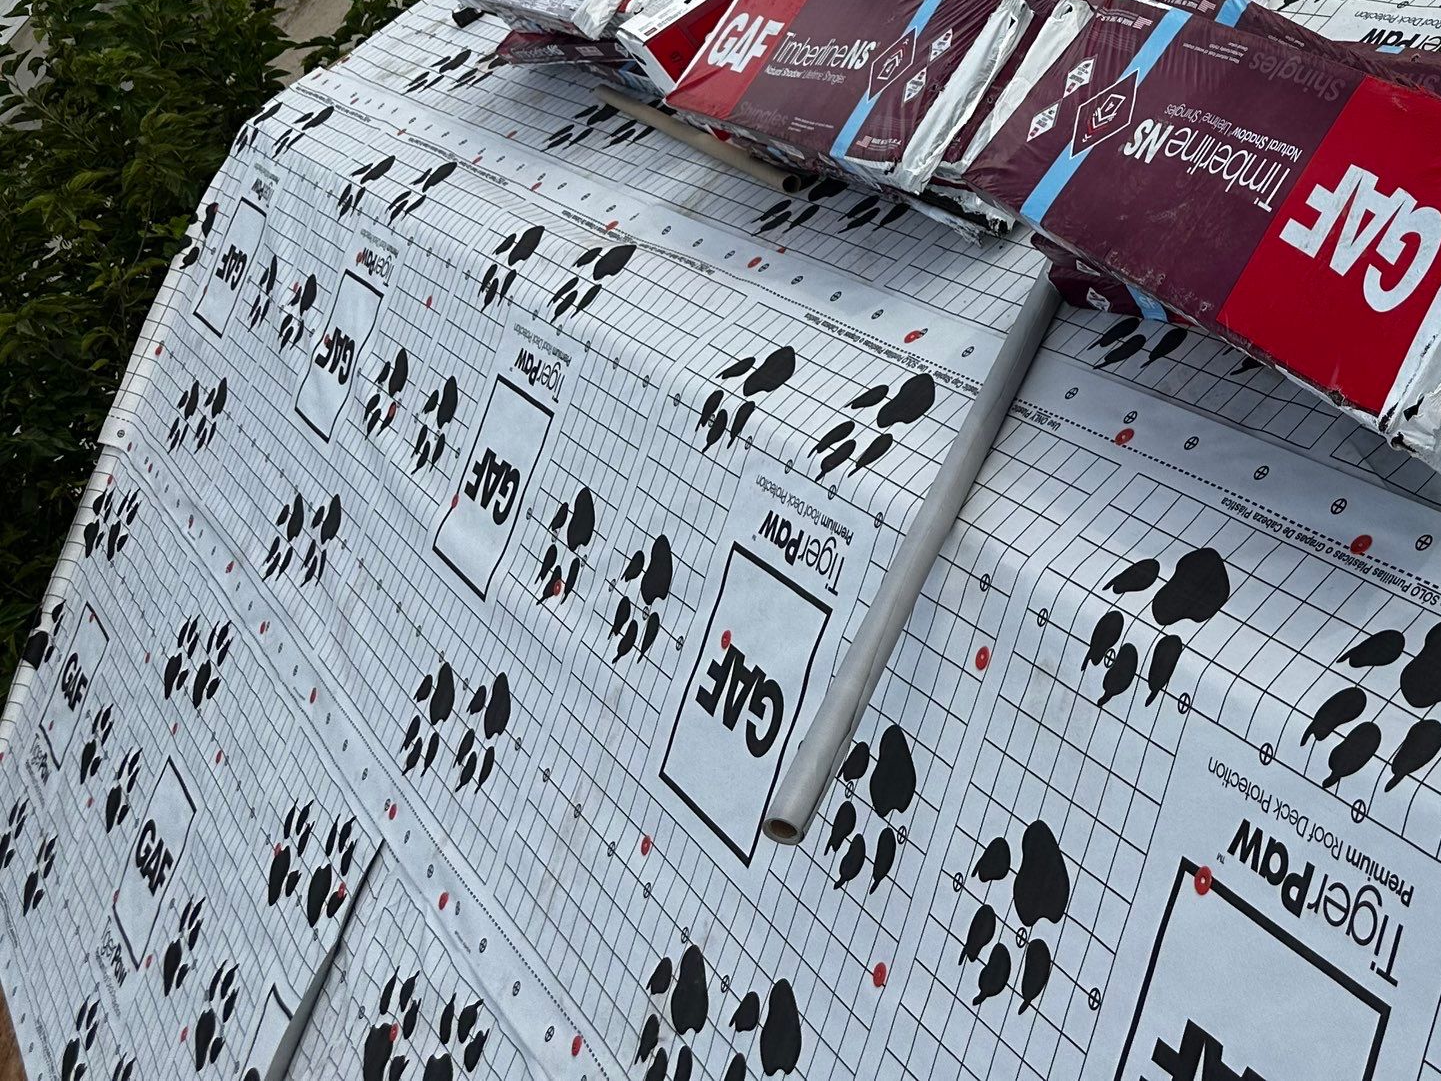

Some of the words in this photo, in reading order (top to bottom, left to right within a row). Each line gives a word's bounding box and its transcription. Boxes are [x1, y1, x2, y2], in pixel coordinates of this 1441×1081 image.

[1354, 11, 1400, 25] Protection
[706, 12, 785, 73] GAF
[772, 30, 877, 70] TimberlineNS
[1164, 102, 1204, 124] Shingles
[1232, 123, 1271, 150] Shadow
[1269, 139, 1304, 163] Natural
[1120, 115, 1293, 213] TimberlineNS
[215, 244, 248, 291] GAF
[464, 447, 521, 526] GAF
[1220, 497, 1251, 520] Plástica
[1252, 511, 1284, 532] Cabeza
[820, 514, 854, 546] Premium
[1285, 527, 1298, 539] De
[1297, 532, 1326, 552] Grapas
[758, 509, 845, 597] TigerPaw
[1333, 551, 1371, 575] Plásticas
[1372, 567, 1411, 593] Puntillas
[61, 651, 89, 712] GAF
[695, 643, 785, 758] GAF
[1208, 756, 1272, 814] Protection
[1274, 797, 1310, 838] Deck
[134, 818, 174, 897] GAF
[1307, 822, 1344, 861] Roof
[1347, 844, 1415, 908] Premium
[1227, 817, 1404, 988] TigerPaw
